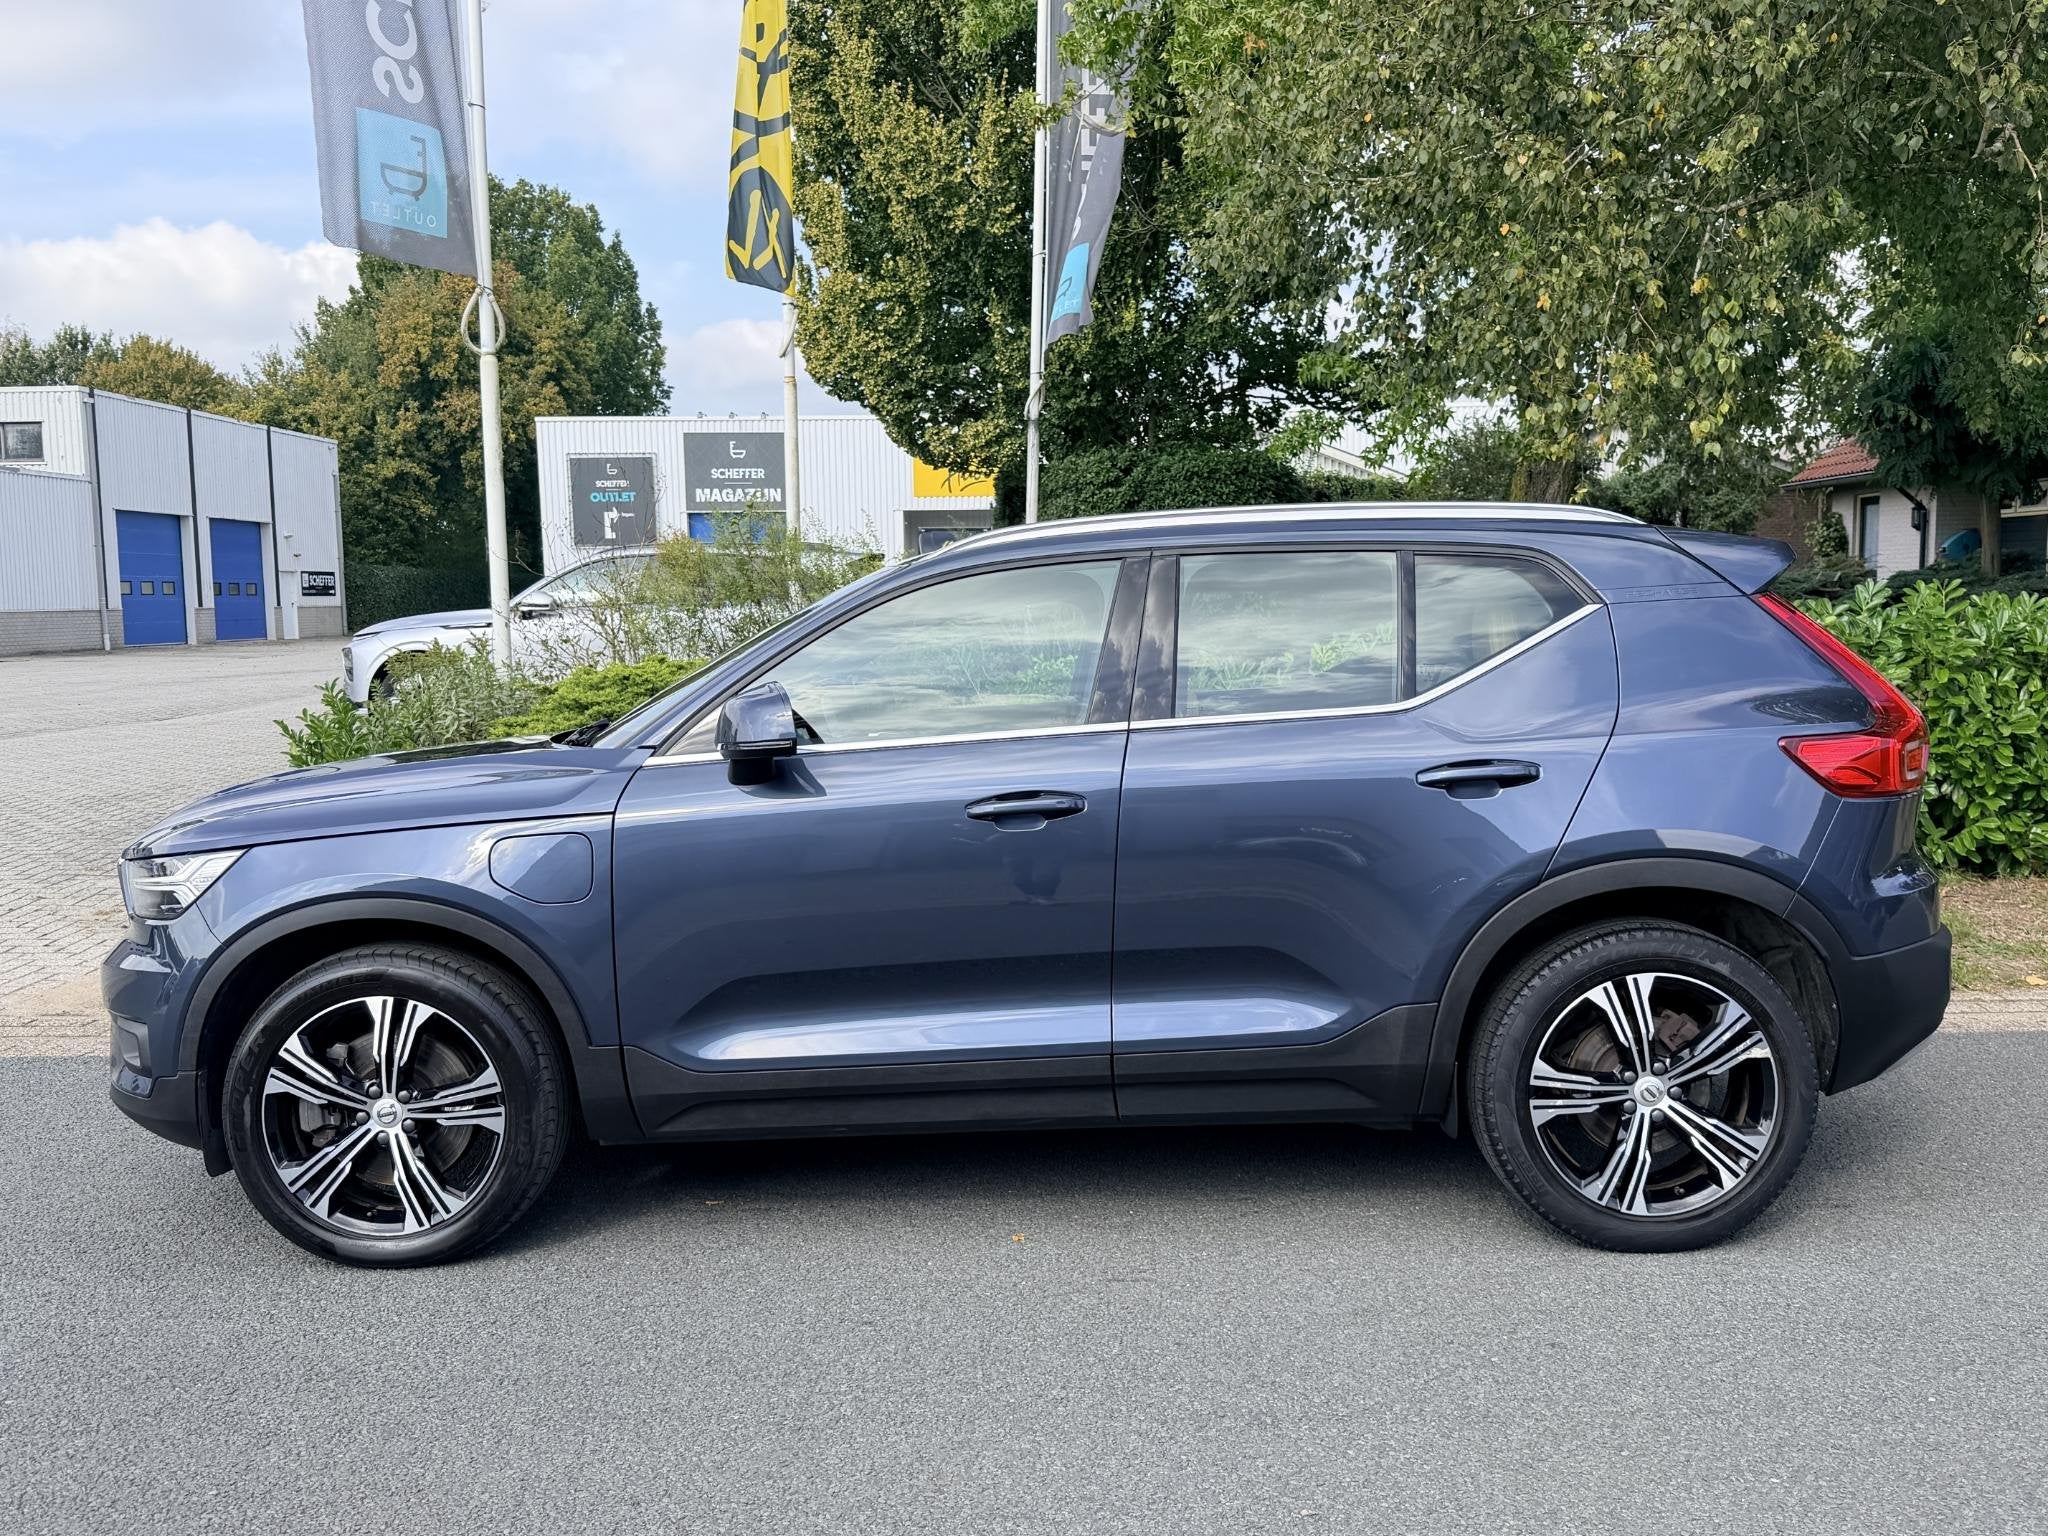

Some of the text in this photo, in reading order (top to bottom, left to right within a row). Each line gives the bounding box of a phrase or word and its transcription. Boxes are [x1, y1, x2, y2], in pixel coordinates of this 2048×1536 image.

[711, 468, 766, 479] SCHEFFER
[590, 492, 637, 502] OUTLET
[310, 575, 334, 586] SCHEFFER
